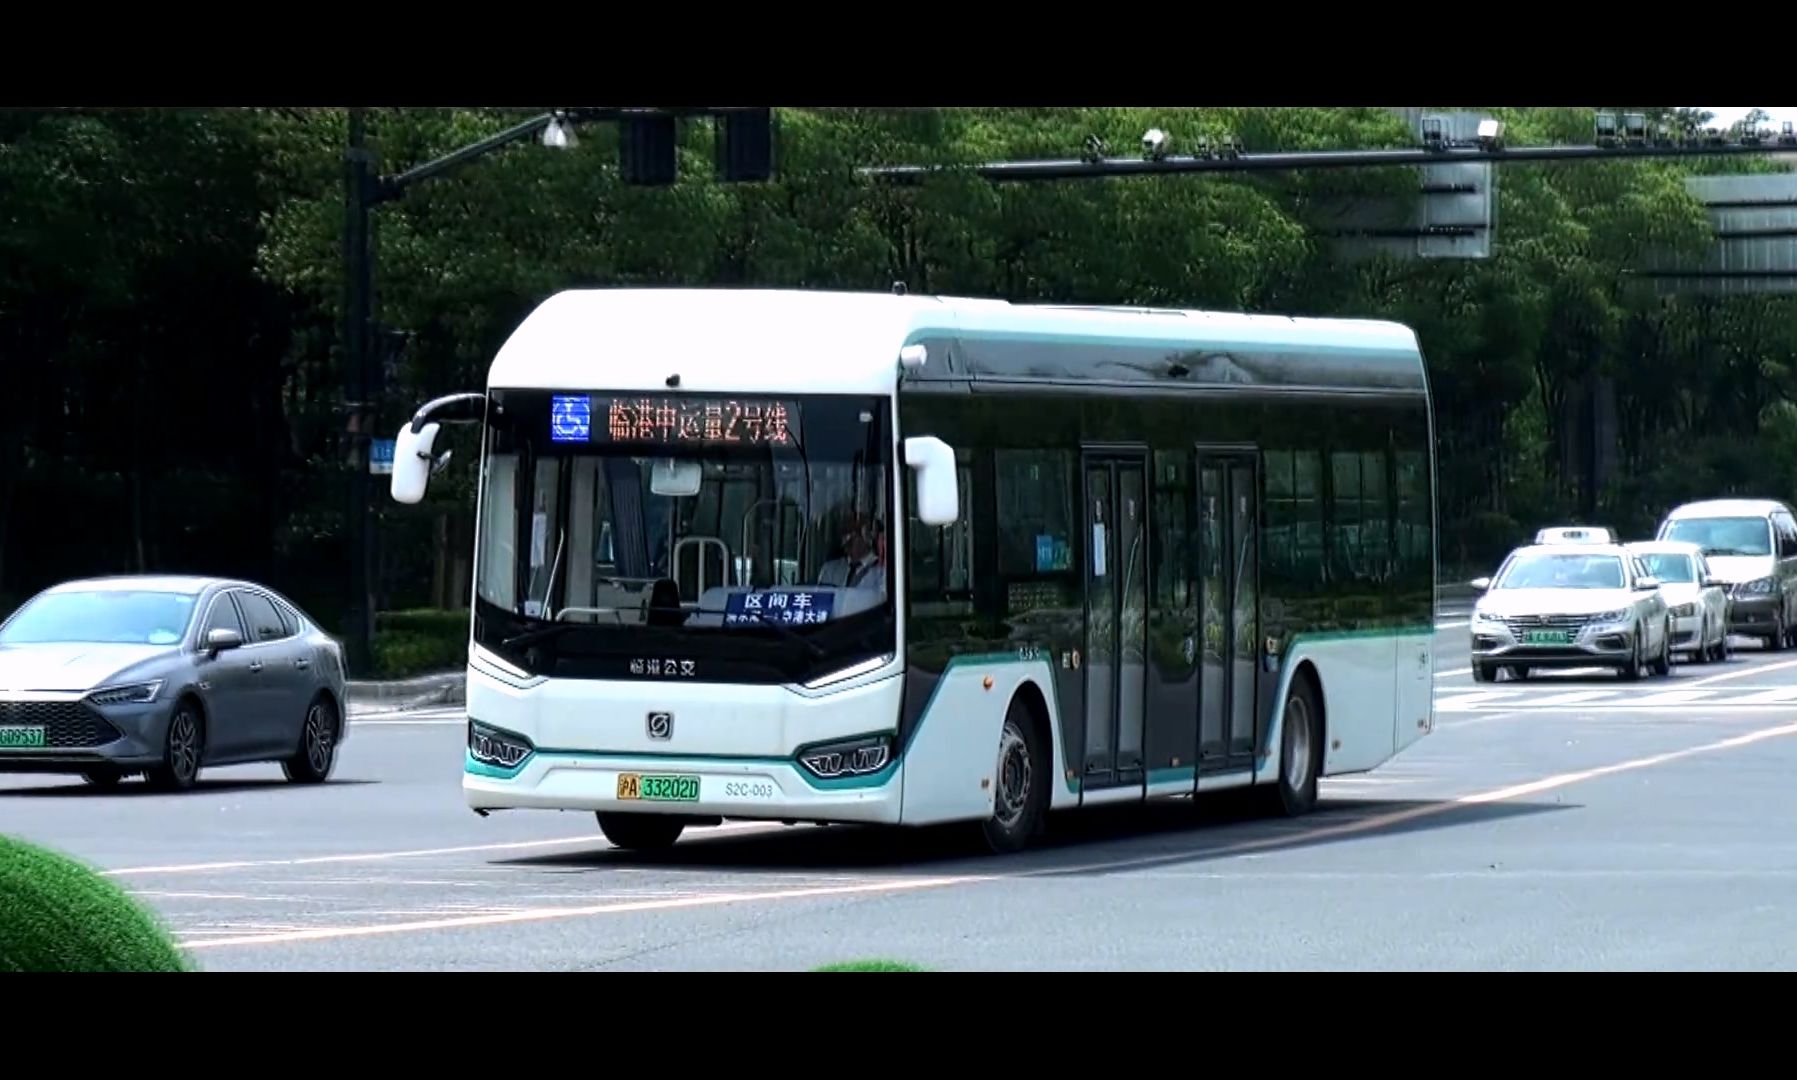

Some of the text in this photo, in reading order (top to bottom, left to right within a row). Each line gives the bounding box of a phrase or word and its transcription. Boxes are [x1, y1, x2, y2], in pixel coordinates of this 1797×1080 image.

[609, 398, 788, 443] 临港中运量2号线
[743, 592, 813, 609] 区间车
[629, 658, 696, 676] 临港公交
[725, 782, 773, 799] S2C-003
